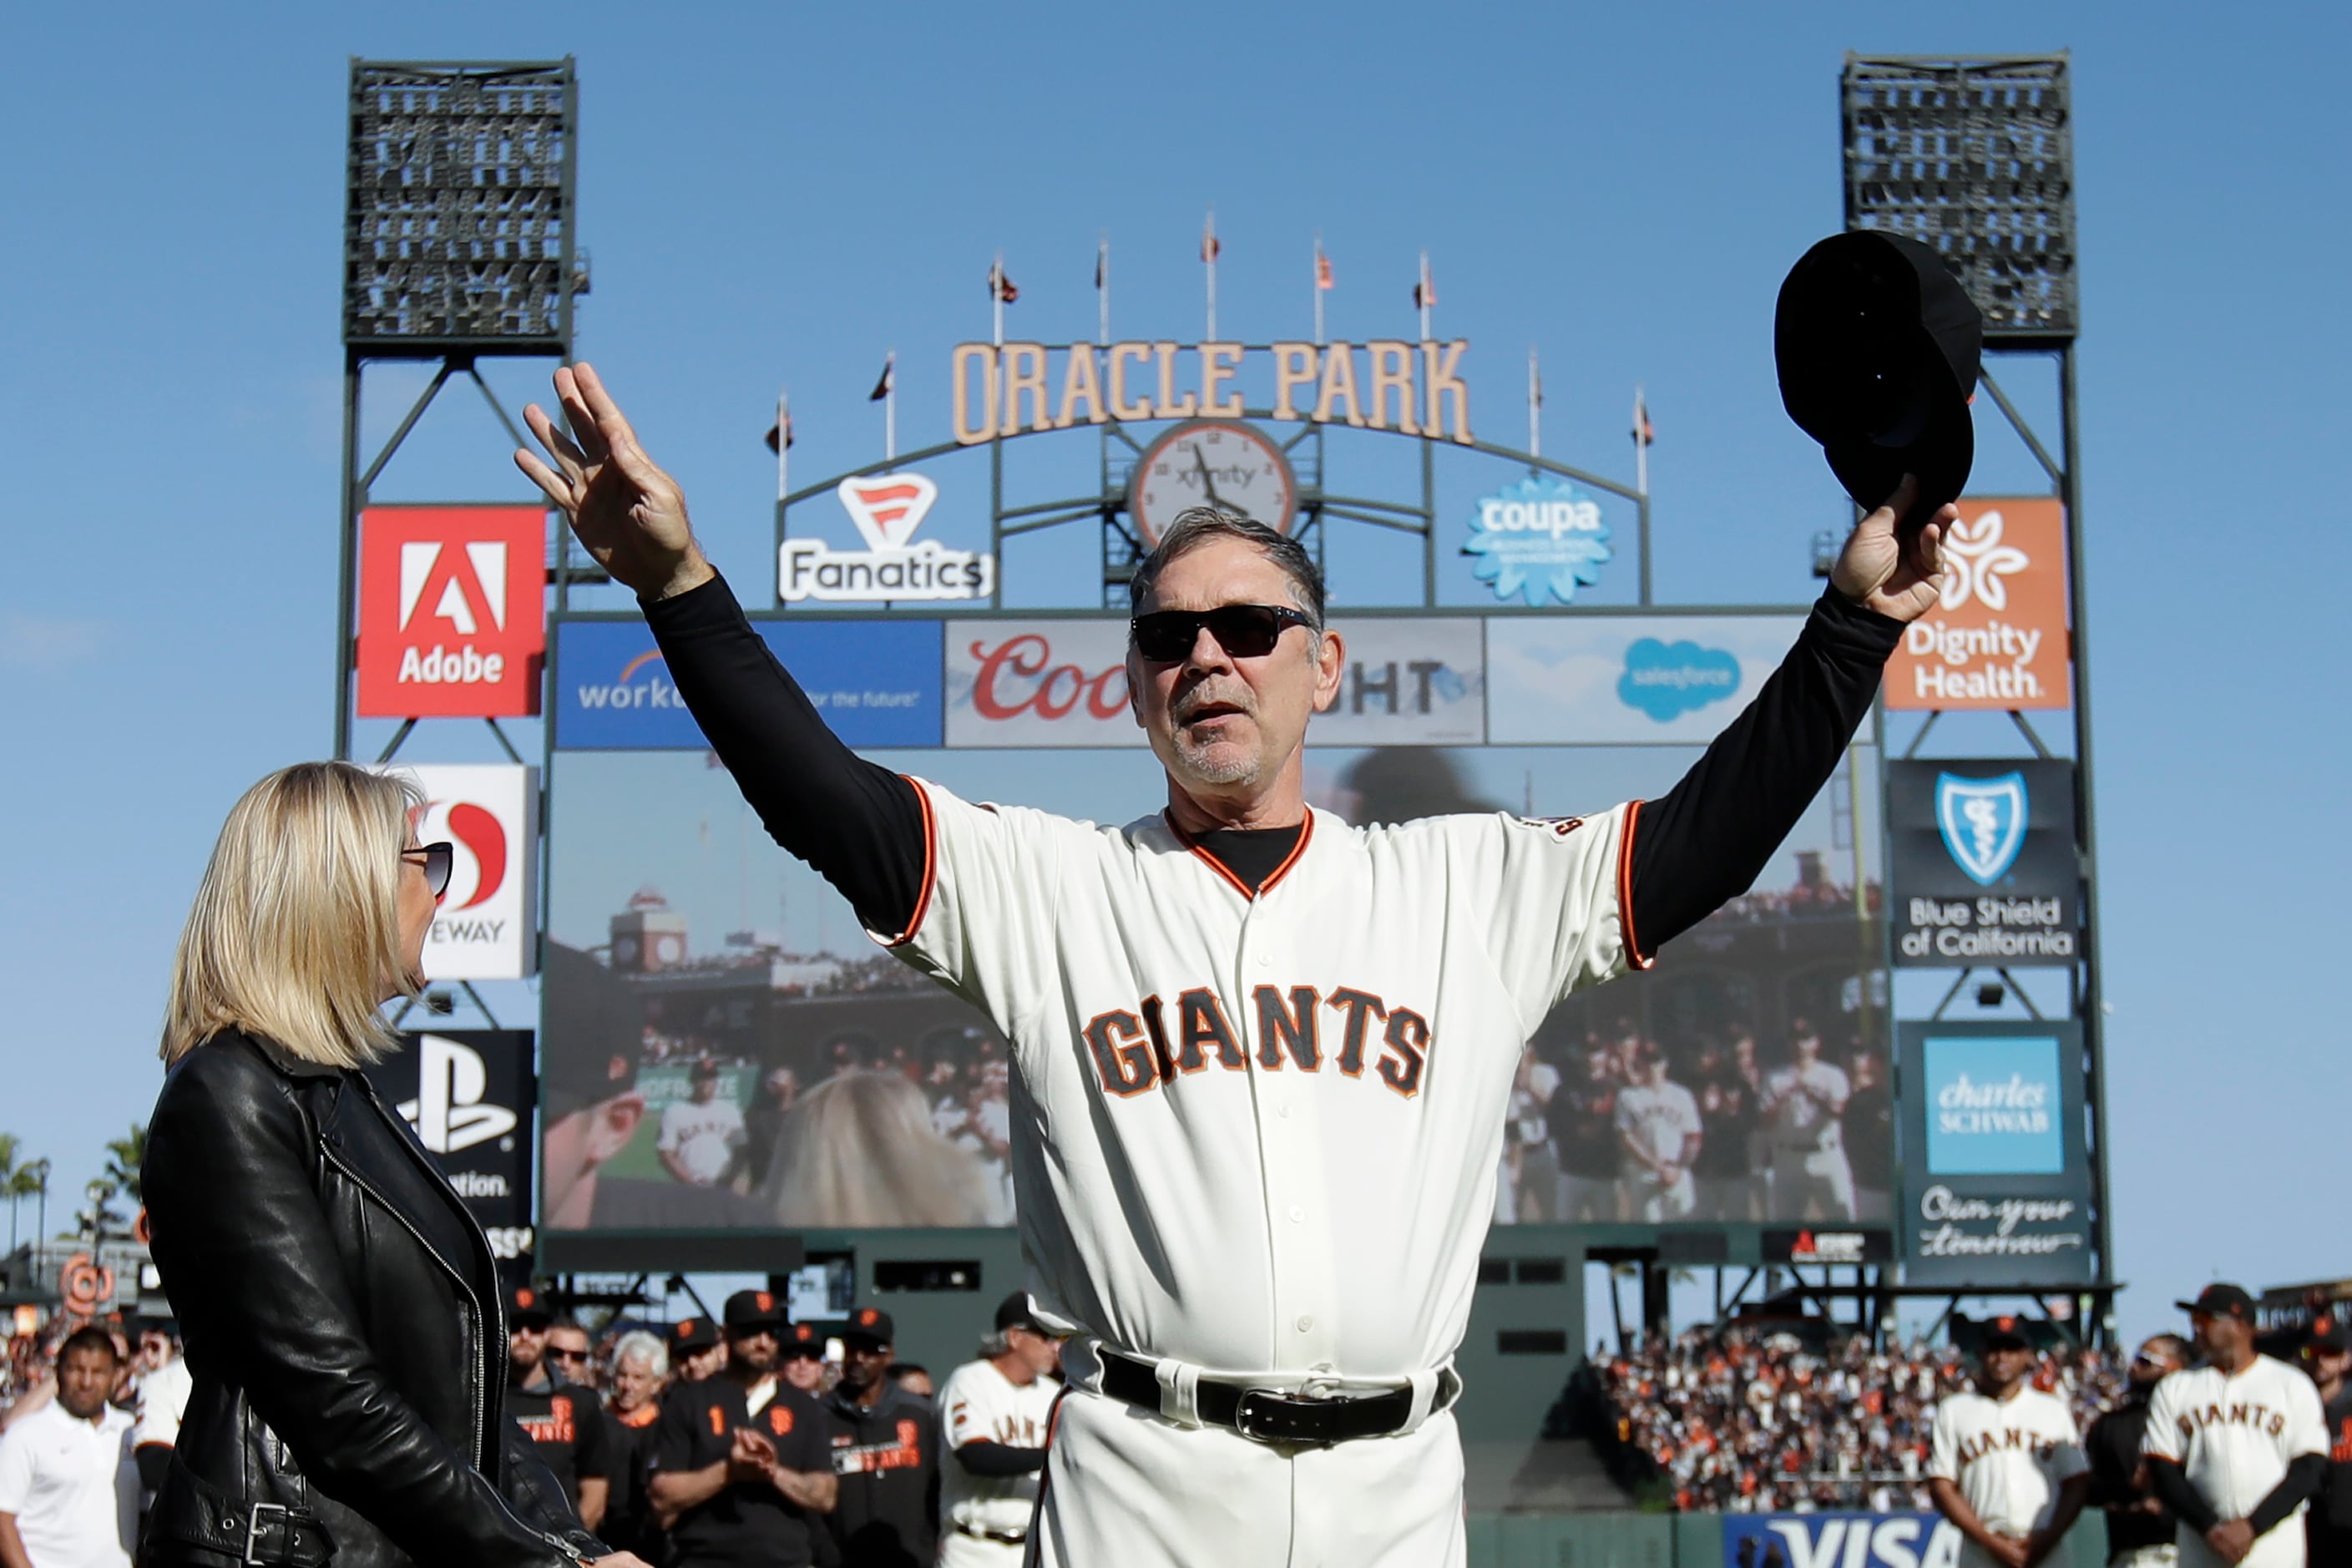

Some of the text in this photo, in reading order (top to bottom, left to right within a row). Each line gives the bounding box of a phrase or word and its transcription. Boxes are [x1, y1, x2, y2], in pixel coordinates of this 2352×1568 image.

[953, 338, 1474, 446] ORACLE PARK
[1482, 501, 1601, 540] coupa
[790, 550, 984, 590] Fanatics
[1906, 620, 2041, 665] Dignity
[398, 643, 503, 684] Adobe
[1633, 665, 1732, 690] salesforce
[1914, 663, 2039, 699] Health
[832, 692, 858, 707] the
[1313, 660, 1444, 716] HT
[1909, 896, 2061, 926] Blue Shield
[431, 920, 506, 943] EWAY
[1901, 927, 2074, 957] of California
[1082, 984, 1432, 1100] GIANTS
[1939, 1074, 2046, 1109] charles
[1940, 1110, 2049, 1134] SCHWAB
[1921, 1184, 2076, 1237] Own your
[1765, 1517, 1963, 1568] VISA
